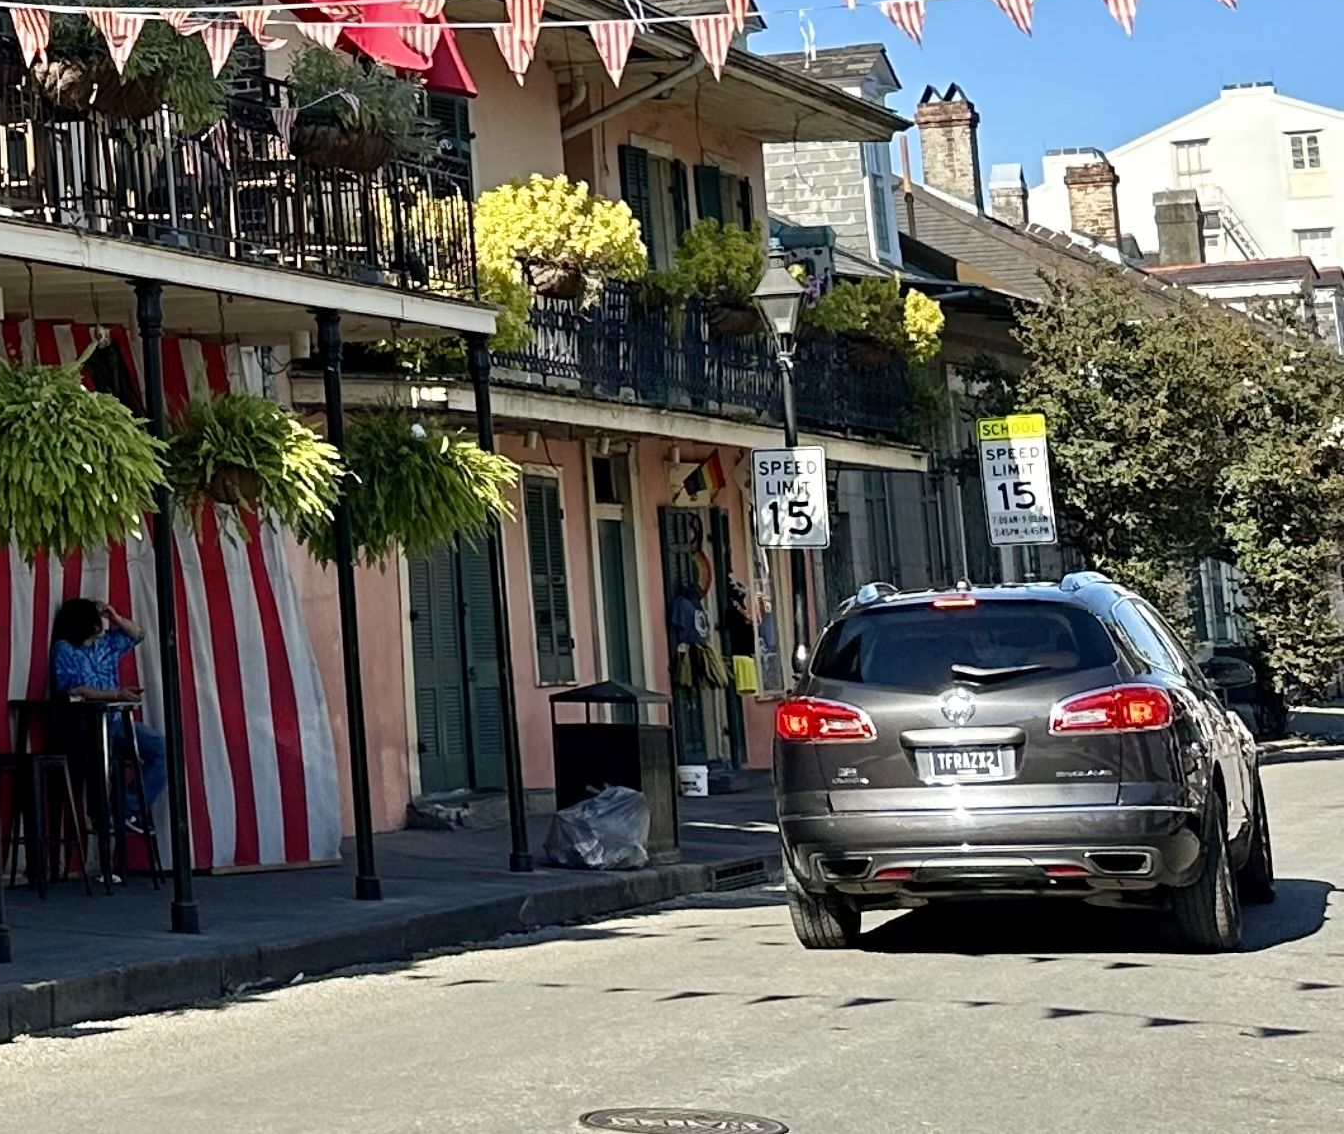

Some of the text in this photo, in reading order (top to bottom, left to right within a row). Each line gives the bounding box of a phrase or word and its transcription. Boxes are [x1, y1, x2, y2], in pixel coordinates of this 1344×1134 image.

[982, 421, 1039, 437] SCHOOL
[986, 447, 1040, 461] SPEED
[759, 460, 817, 476] SPEED
[992, 463, 1034, 477] LIMIT
[765, 480, 811, 496] LIMIT
[997, 481, 1036, 510] 15
[769, 501, 813, 535] 15
